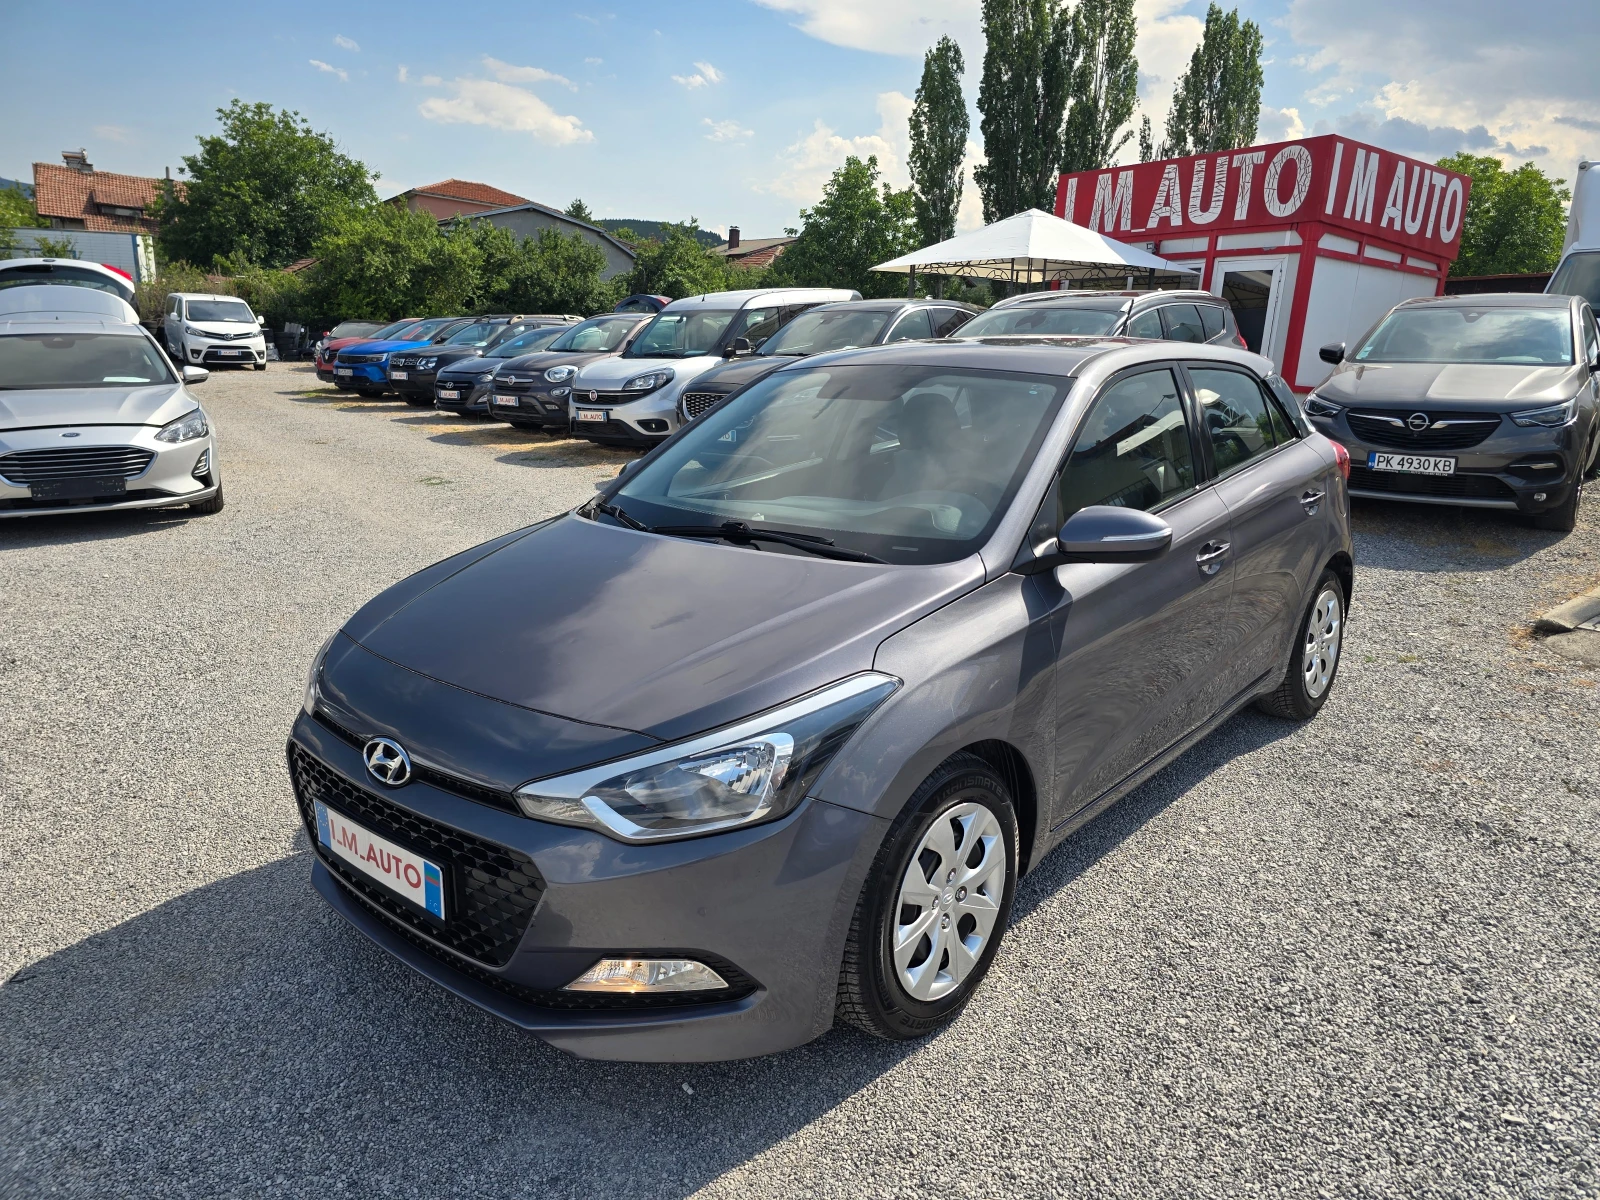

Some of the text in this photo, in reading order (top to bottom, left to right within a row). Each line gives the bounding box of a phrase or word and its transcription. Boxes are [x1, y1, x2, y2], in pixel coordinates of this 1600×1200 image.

[1325, 142, 1463, 244] I M AUTO
[1376, 455, 1394, 468] PK
[1397, 457, 1431, 471] 4930
[1433, 459, 1452, 472] KB
[933, 775, 1003, 805] TRANSMATE
